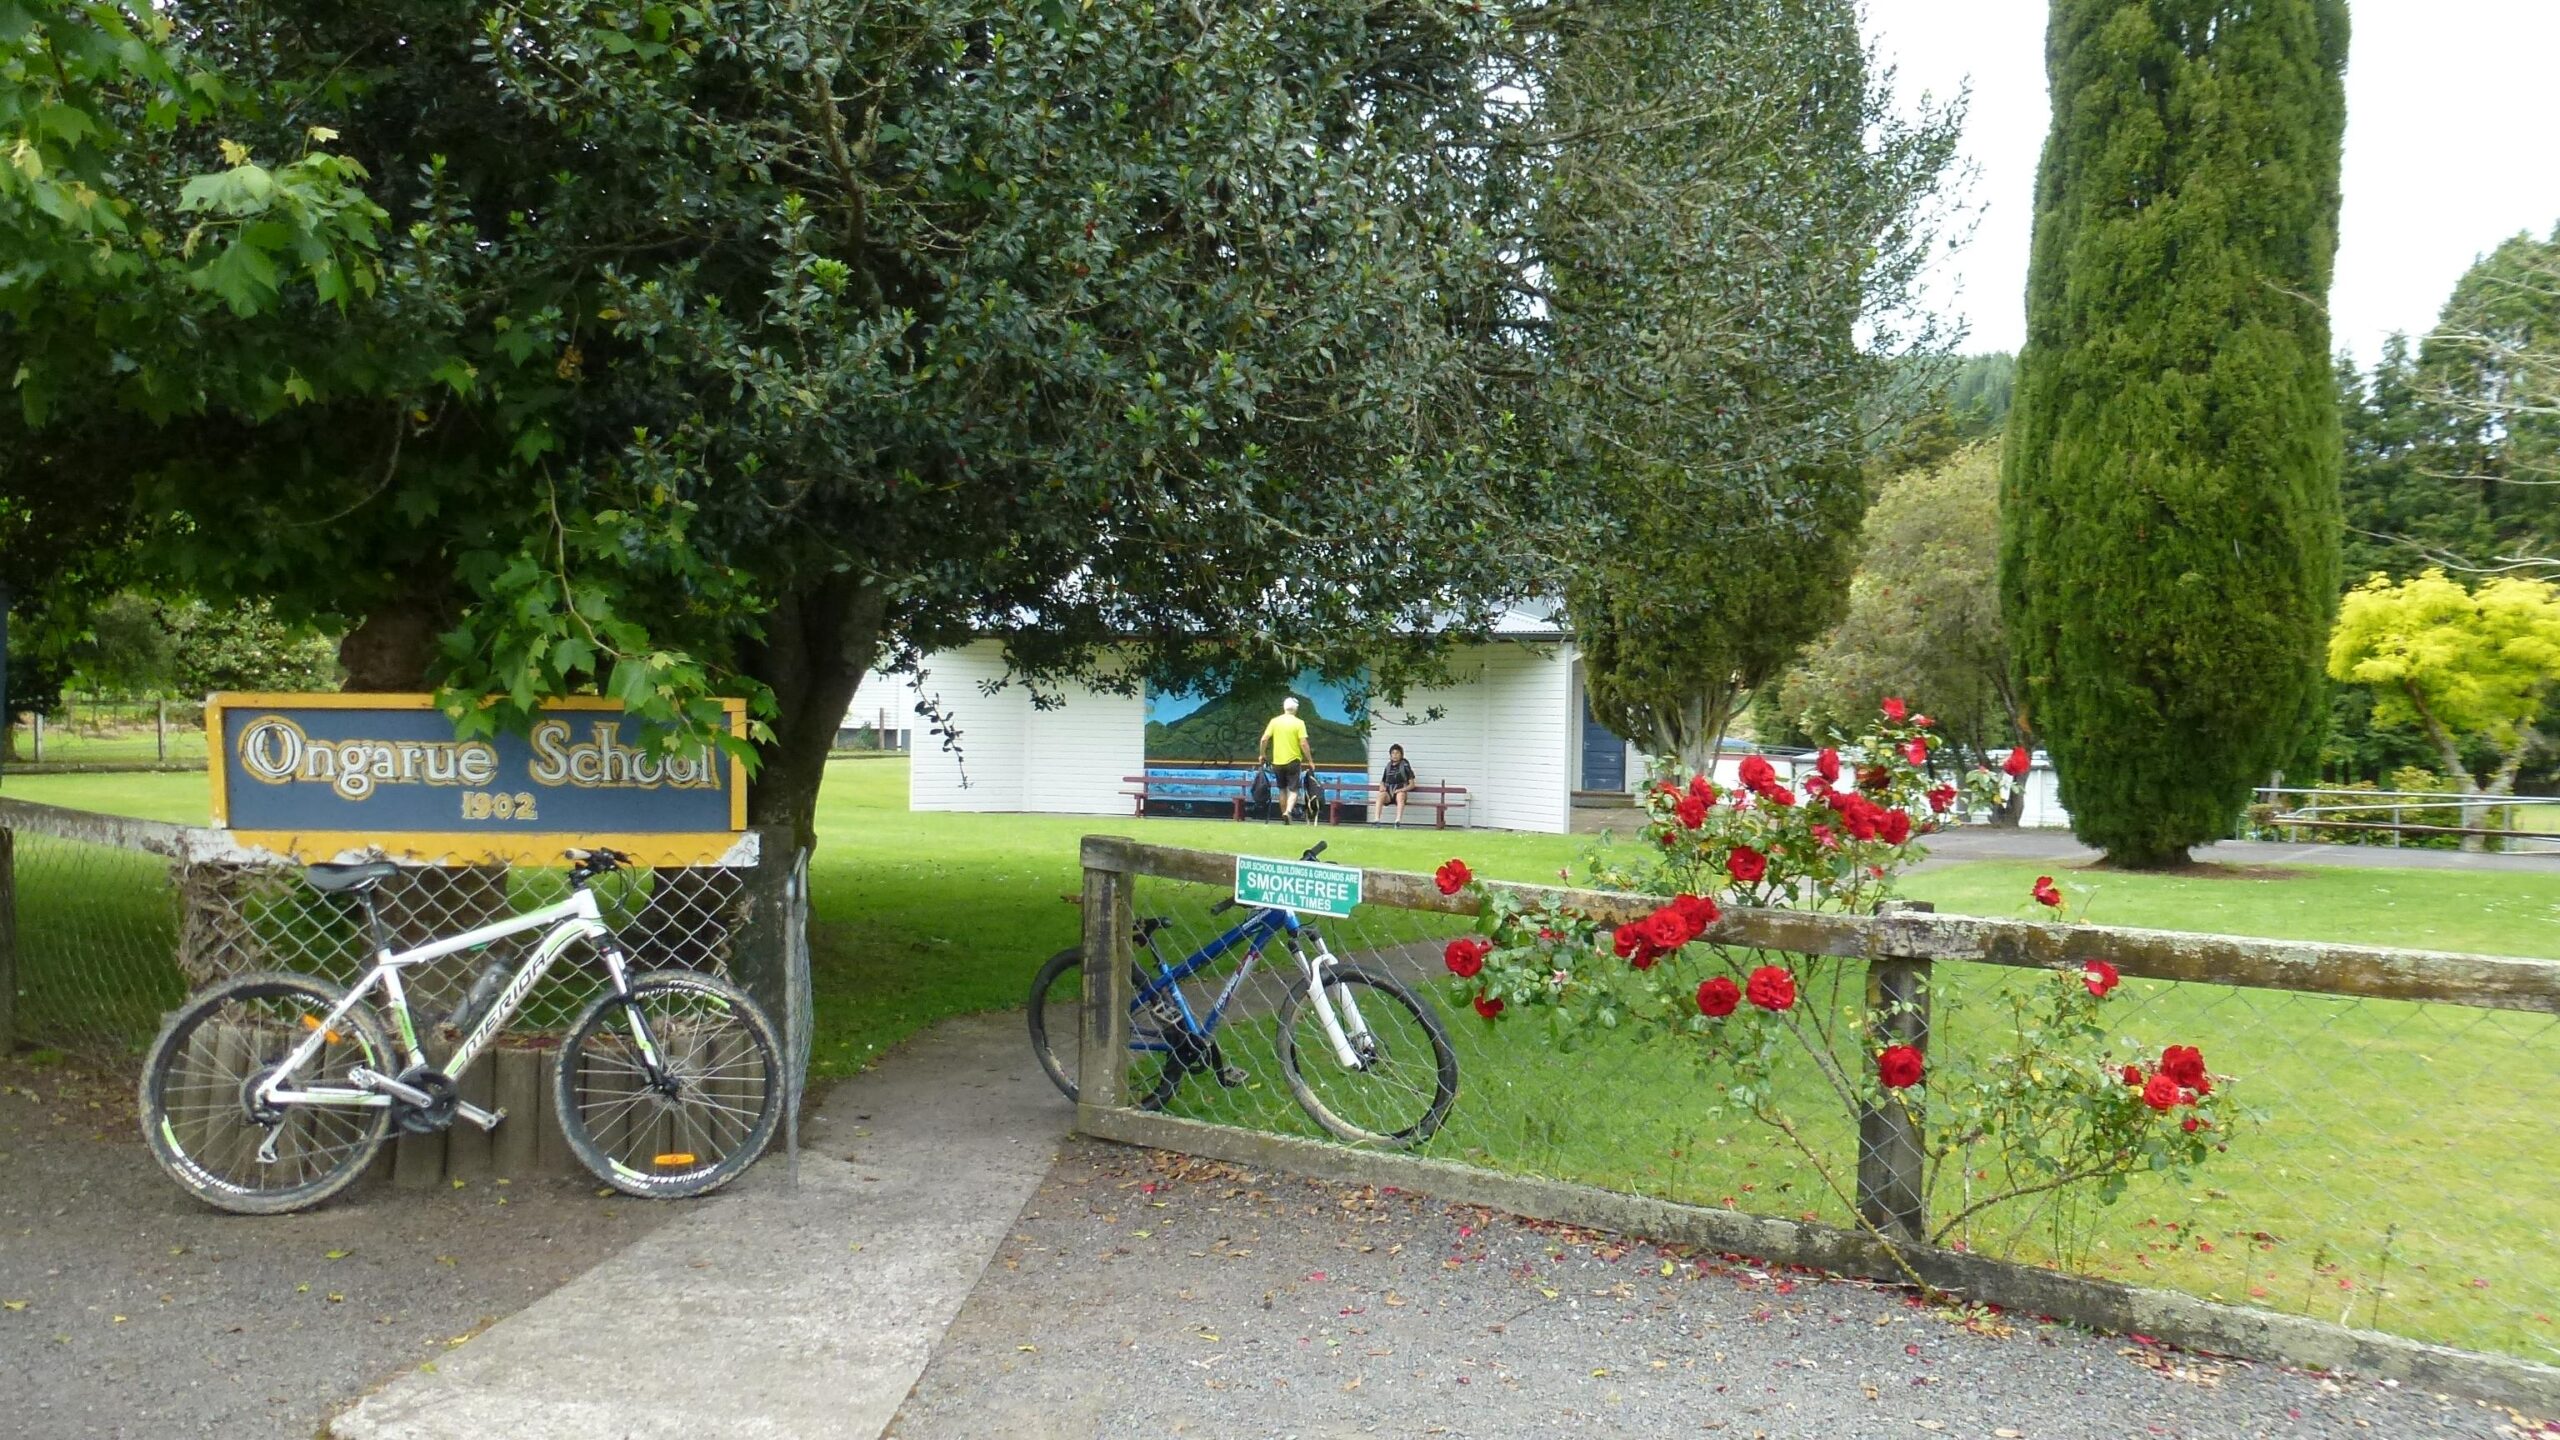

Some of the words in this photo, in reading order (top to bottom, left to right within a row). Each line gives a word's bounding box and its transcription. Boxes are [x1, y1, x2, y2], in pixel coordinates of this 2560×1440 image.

[239, 716, 498, 800] Ongarue
[529, 721, 720, 789] School
[462, 791, 538, 819] 1902
[1240, 860, 1251, 870] OUR
[1253, 862, 1276, 873] SCHOOL
[1276, 865, 1309, 878] BUILDINGS
[1314, 870, 1344, 882] GROUNDS
[1345, 873, 1359, 884] ARE
[1247, 871, 1349, 900] SMOKEFREE
[1261, 890, 1276, 903] AT
[1277, 892, 1297, 906] ALL
[1300, 896, 1332, 911] TIMES
[465, 951, 546, 1060] MERIDA
